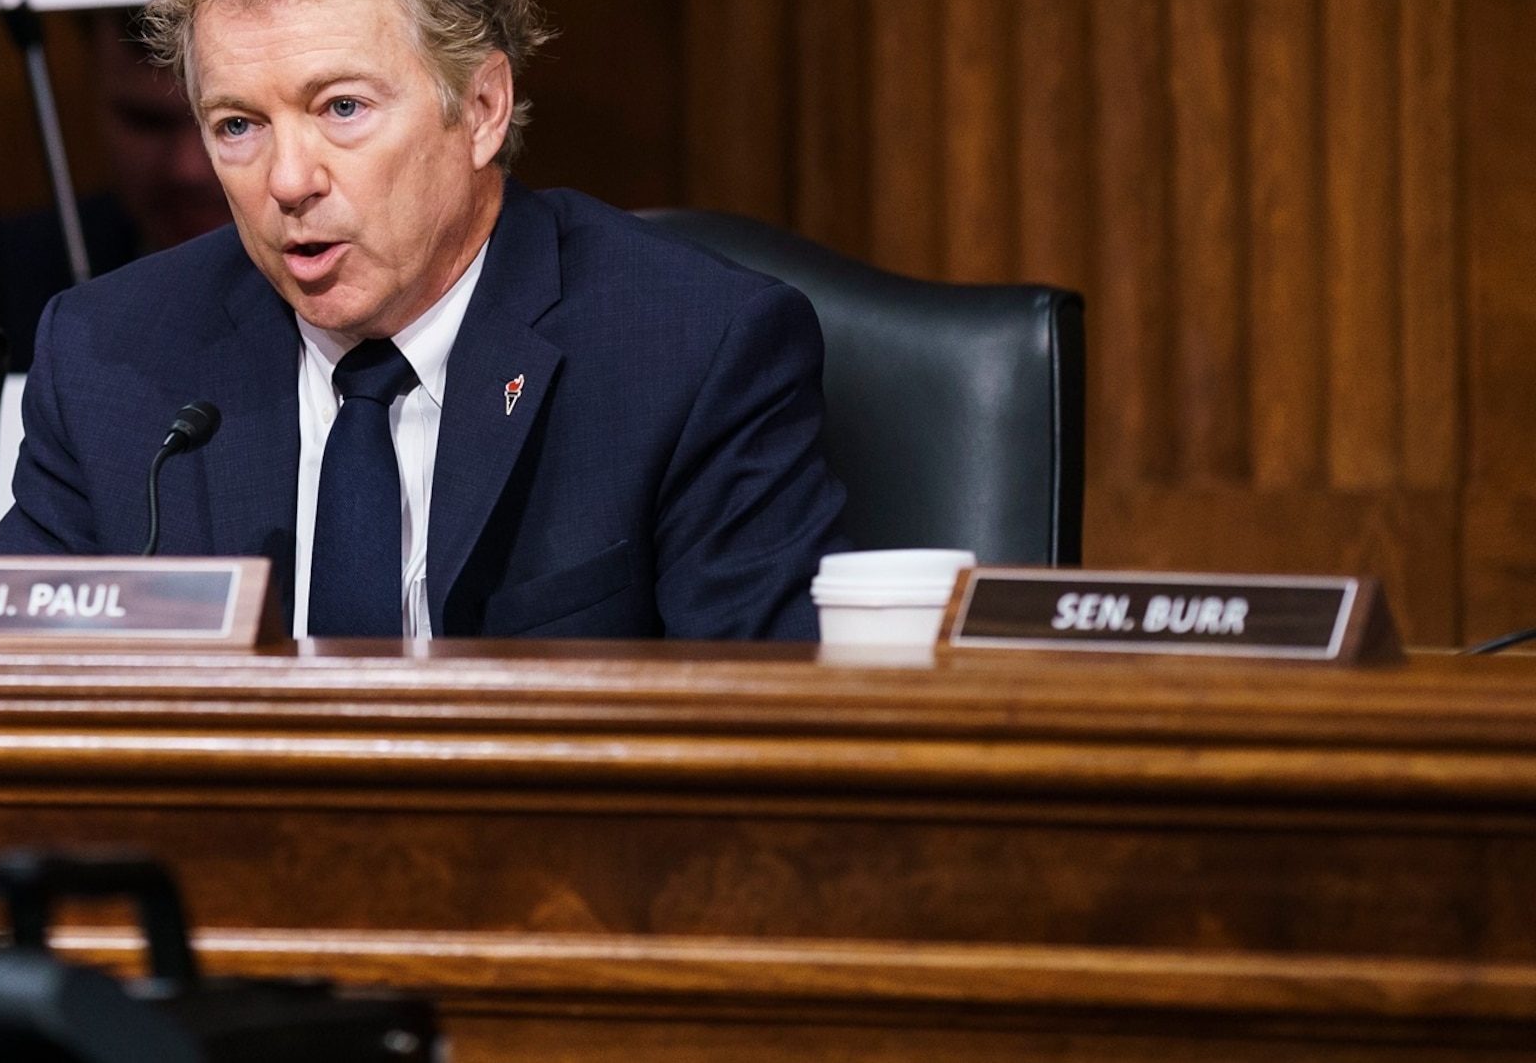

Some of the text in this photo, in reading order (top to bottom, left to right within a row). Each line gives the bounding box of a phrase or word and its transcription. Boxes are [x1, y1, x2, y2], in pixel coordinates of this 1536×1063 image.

[28, 581, 125, 618] PAUL
[1052, 593, 1250, 634] SEN. BURR
